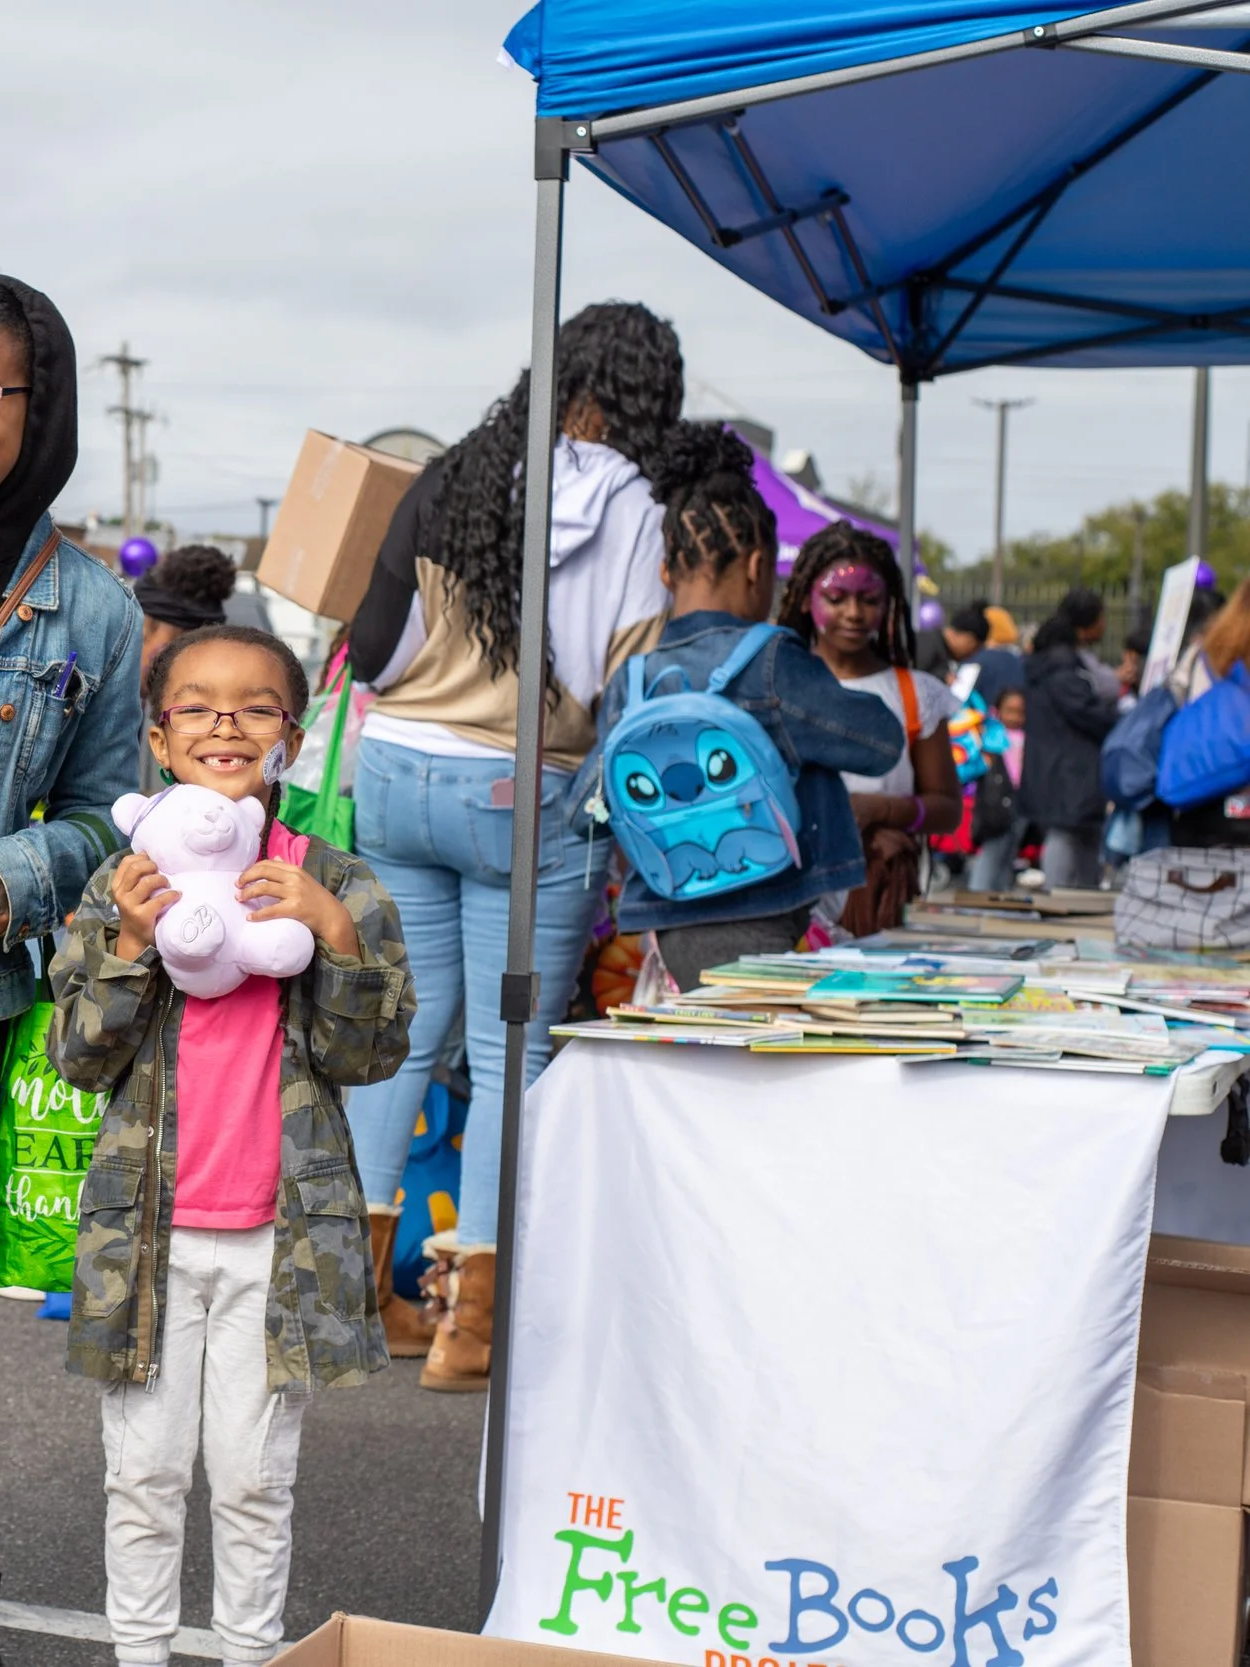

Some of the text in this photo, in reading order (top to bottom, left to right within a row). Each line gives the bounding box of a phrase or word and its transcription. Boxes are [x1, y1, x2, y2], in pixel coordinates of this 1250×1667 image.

[14, 1132, 96, 1171] EAR
[568, 1492, 624, 1530] THE
[539, 1529, 1059, 1667] Free Books
